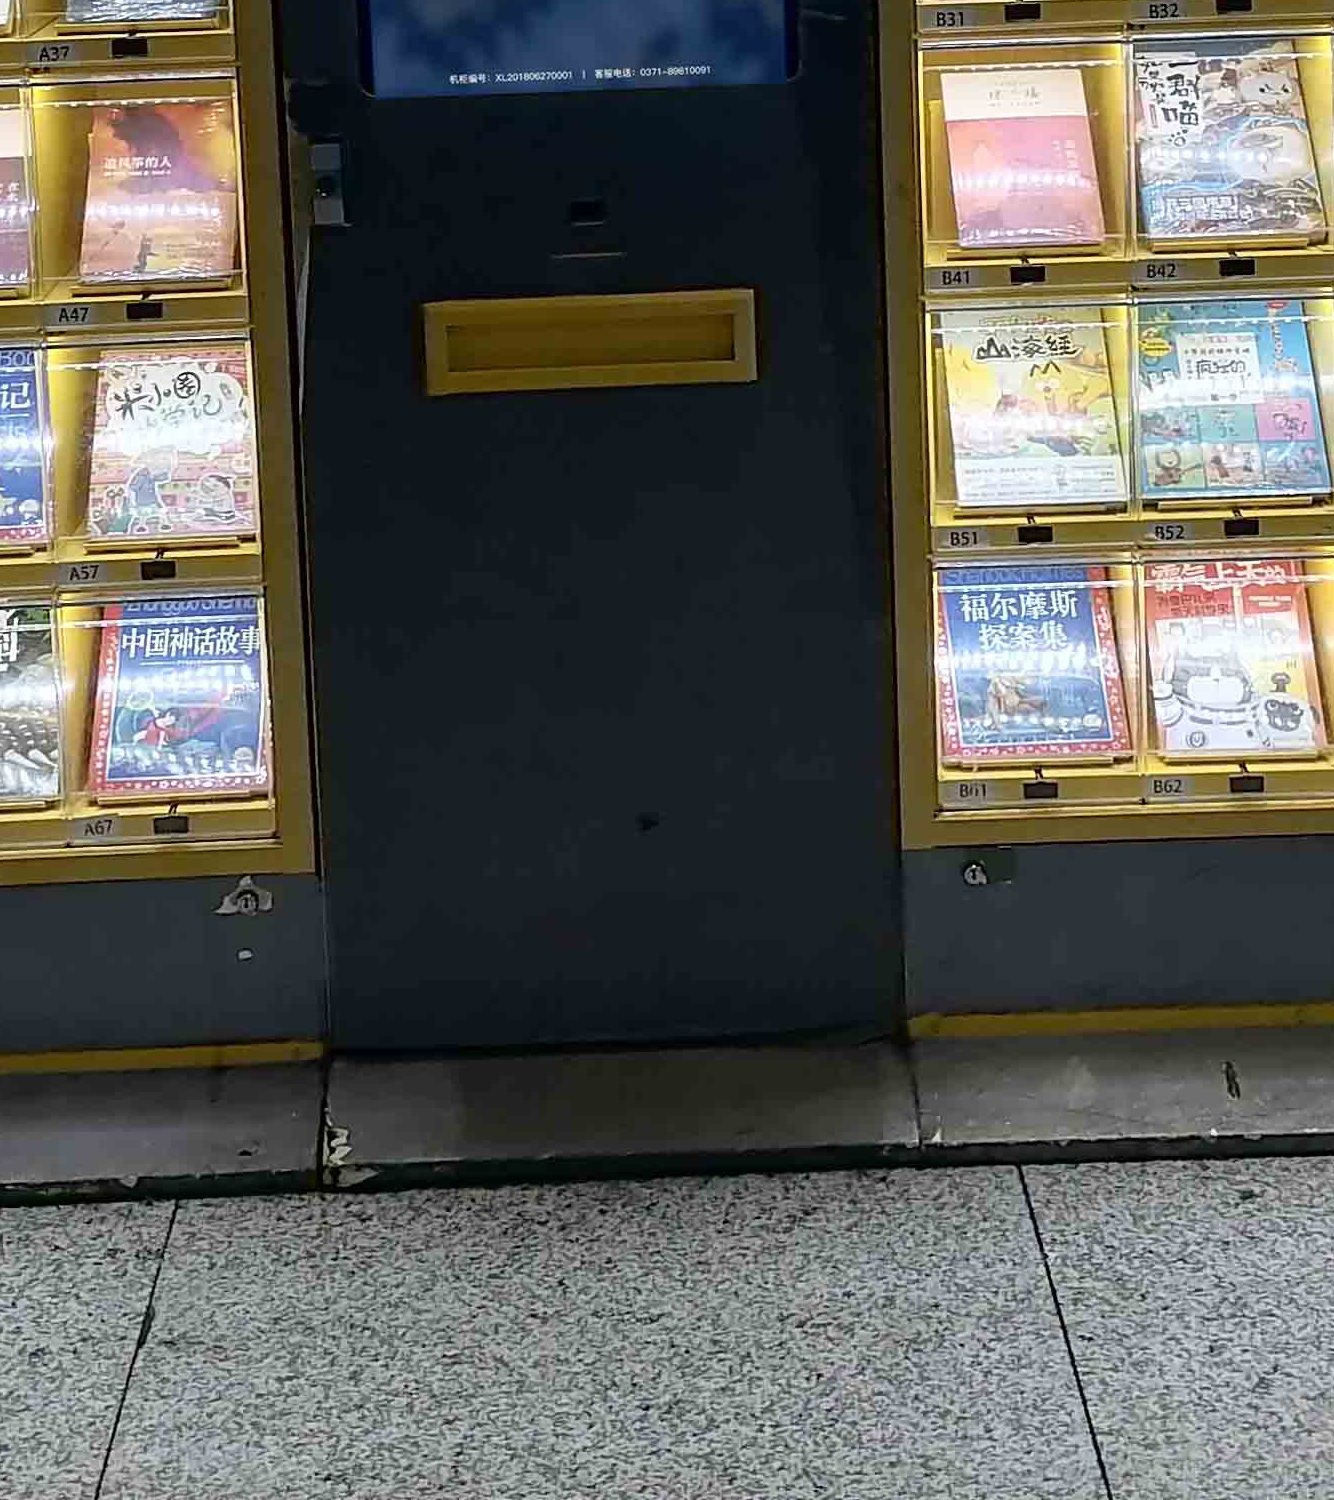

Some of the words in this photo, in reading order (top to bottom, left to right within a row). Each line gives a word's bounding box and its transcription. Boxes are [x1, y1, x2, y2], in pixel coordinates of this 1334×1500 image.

[936, 11, 966, 27] B31
[1148, 3, 1180, 20] B32
[38, 46, 71, 62] A37
[1161, 61, 1201, 128] 一群喵
[942, 270, 971, 285] B41
[1146, 263, 1177, 278] B42
[58, 308, 90, 323] A47
[113, 371, 202, 419] 米小圈
[949, 530, 979, 547] B51
[1154, 524, 1185, 541] B52
[69, 565, 100, 581] A57
[961, 589, 1079, 623] 福尔摩斯
[121, 626, 260, 658] 中国神话故事
[978, 624, 1072, 653] 探案集
[1153, 779, 1183, 795] B62
[83, 820, 114, 837] A67
